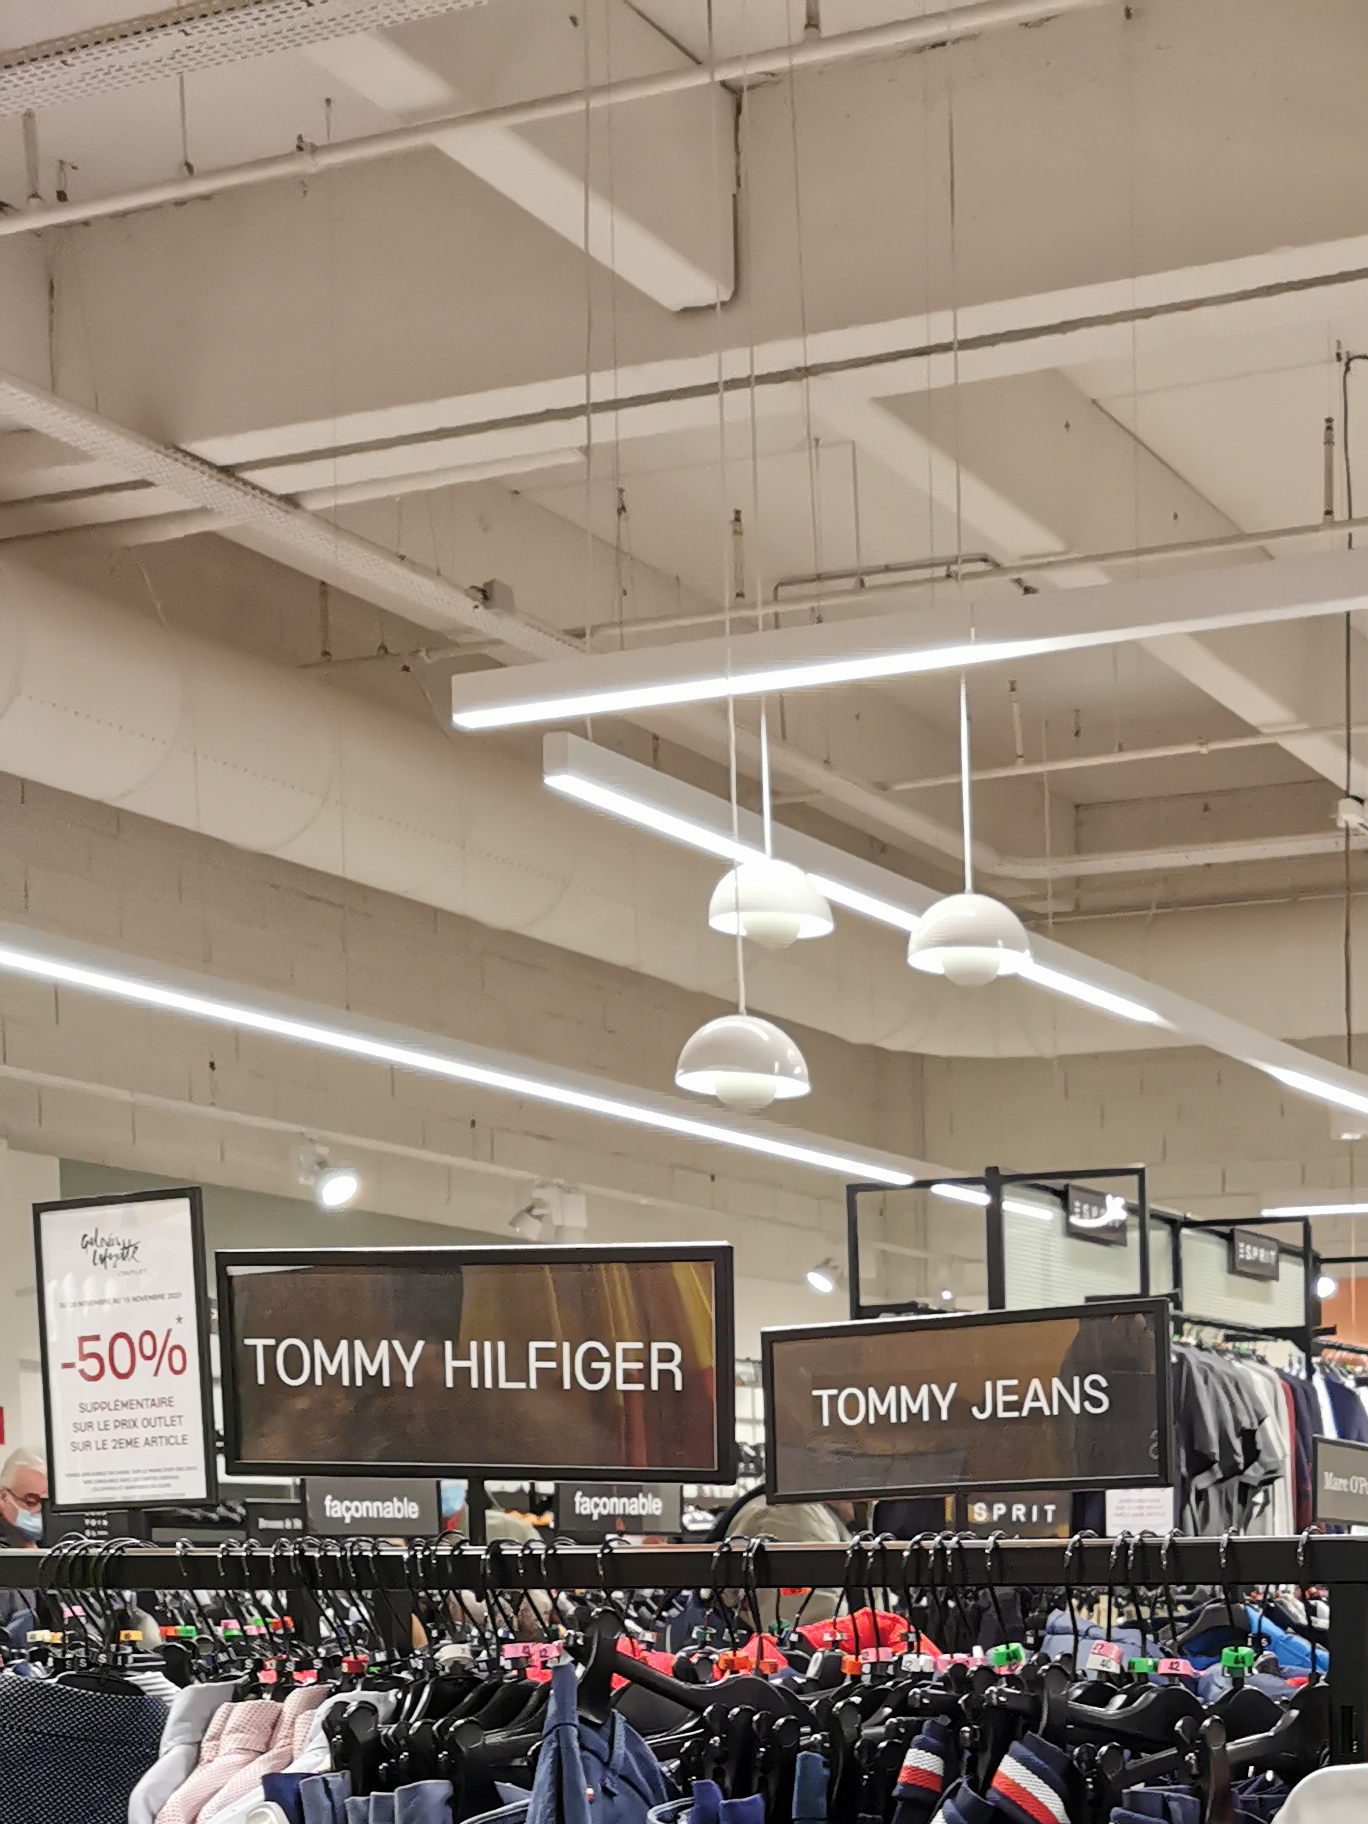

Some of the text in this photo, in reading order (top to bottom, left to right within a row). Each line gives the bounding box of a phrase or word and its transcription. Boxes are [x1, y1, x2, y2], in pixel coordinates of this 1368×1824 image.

[244, 1338, 684, 1391] TOMMY HILFIGER
[79, 1396, 174, 1413] SUPPLÉMENTAIRE
[812, 1373, 1110, 1427] TOMMY JEANS
[72, 1415, 184, 1433] SUR LE PRIX OUTLET
[70, 1441, 92, 1452] SUR
[95, 1440, 108, 1451] LE
[143, 1434, 188, 1447] ARTICLE
[324, 1494, 419, 1524] façonnable
[574, 1490, 663, 1521] façonnable
[973, 1502, 1057, 1523] SPRIT
